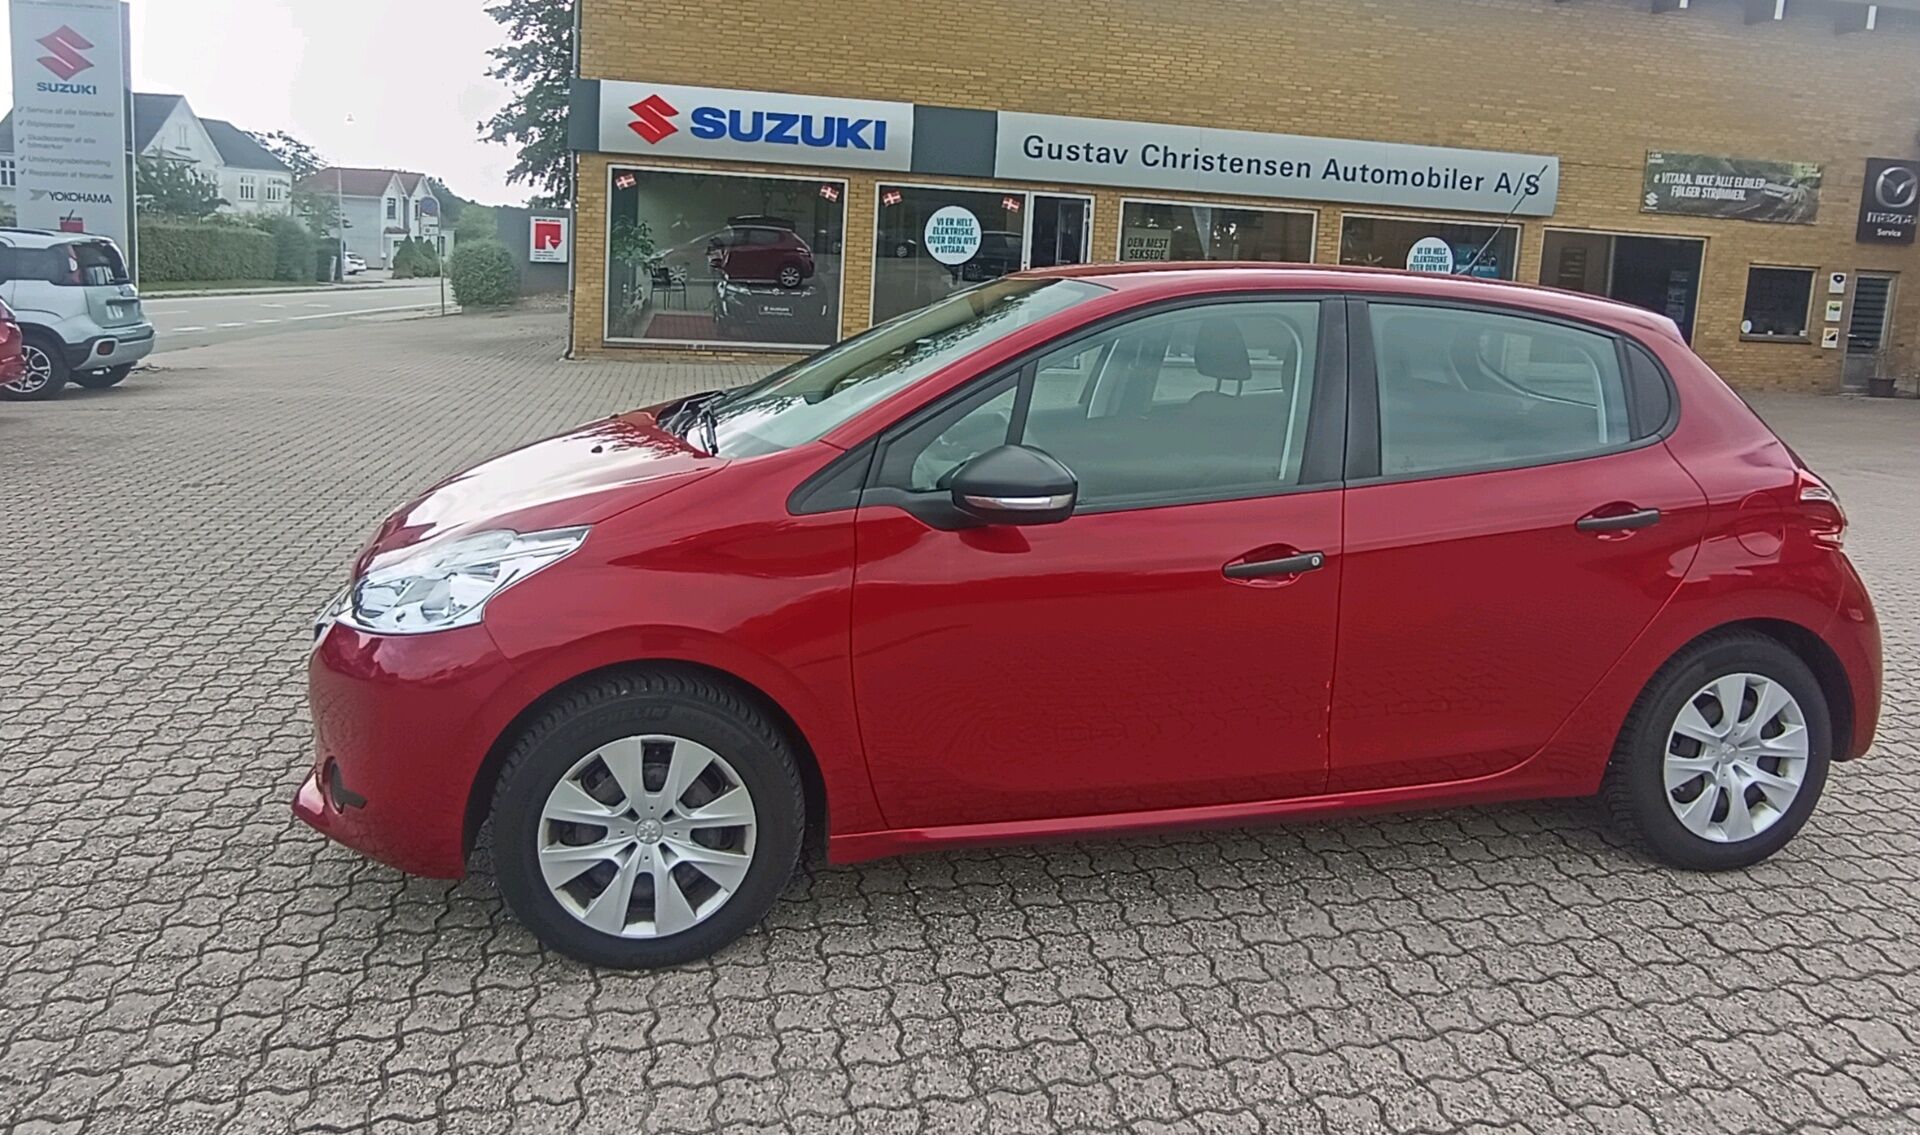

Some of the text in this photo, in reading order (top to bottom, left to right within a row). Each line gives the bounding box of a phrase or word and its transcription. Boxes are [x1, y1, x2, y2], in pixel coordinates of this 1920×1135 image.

[37, 82, 97, 95] SUZUKI
[690, 106, 887, 151] SUZUKI
[1023, 135, 1540, 196] Gustav Christensen Automobiler A/S
[1661, 172, 1694, 185] VITARA.
[1695, 174, 1715, 186] IKKE
[1714, 176, 1734, 187] ALLE
[49, 191, 112, 204] YOKOHAMA
[936, 217, 973, 227] VI ER HELT
[932, 226, 975, 236] ELEKTRISKE
[1876, 228, 1902, 237] Service
[928, 235, 978, 245] OVER DEN NYE
[1127, 237, 1169, 249] DEN MEST
[940, 245, 967, 254] VITARA.
[1129, 248, 1166, 260] SEKSEDE
